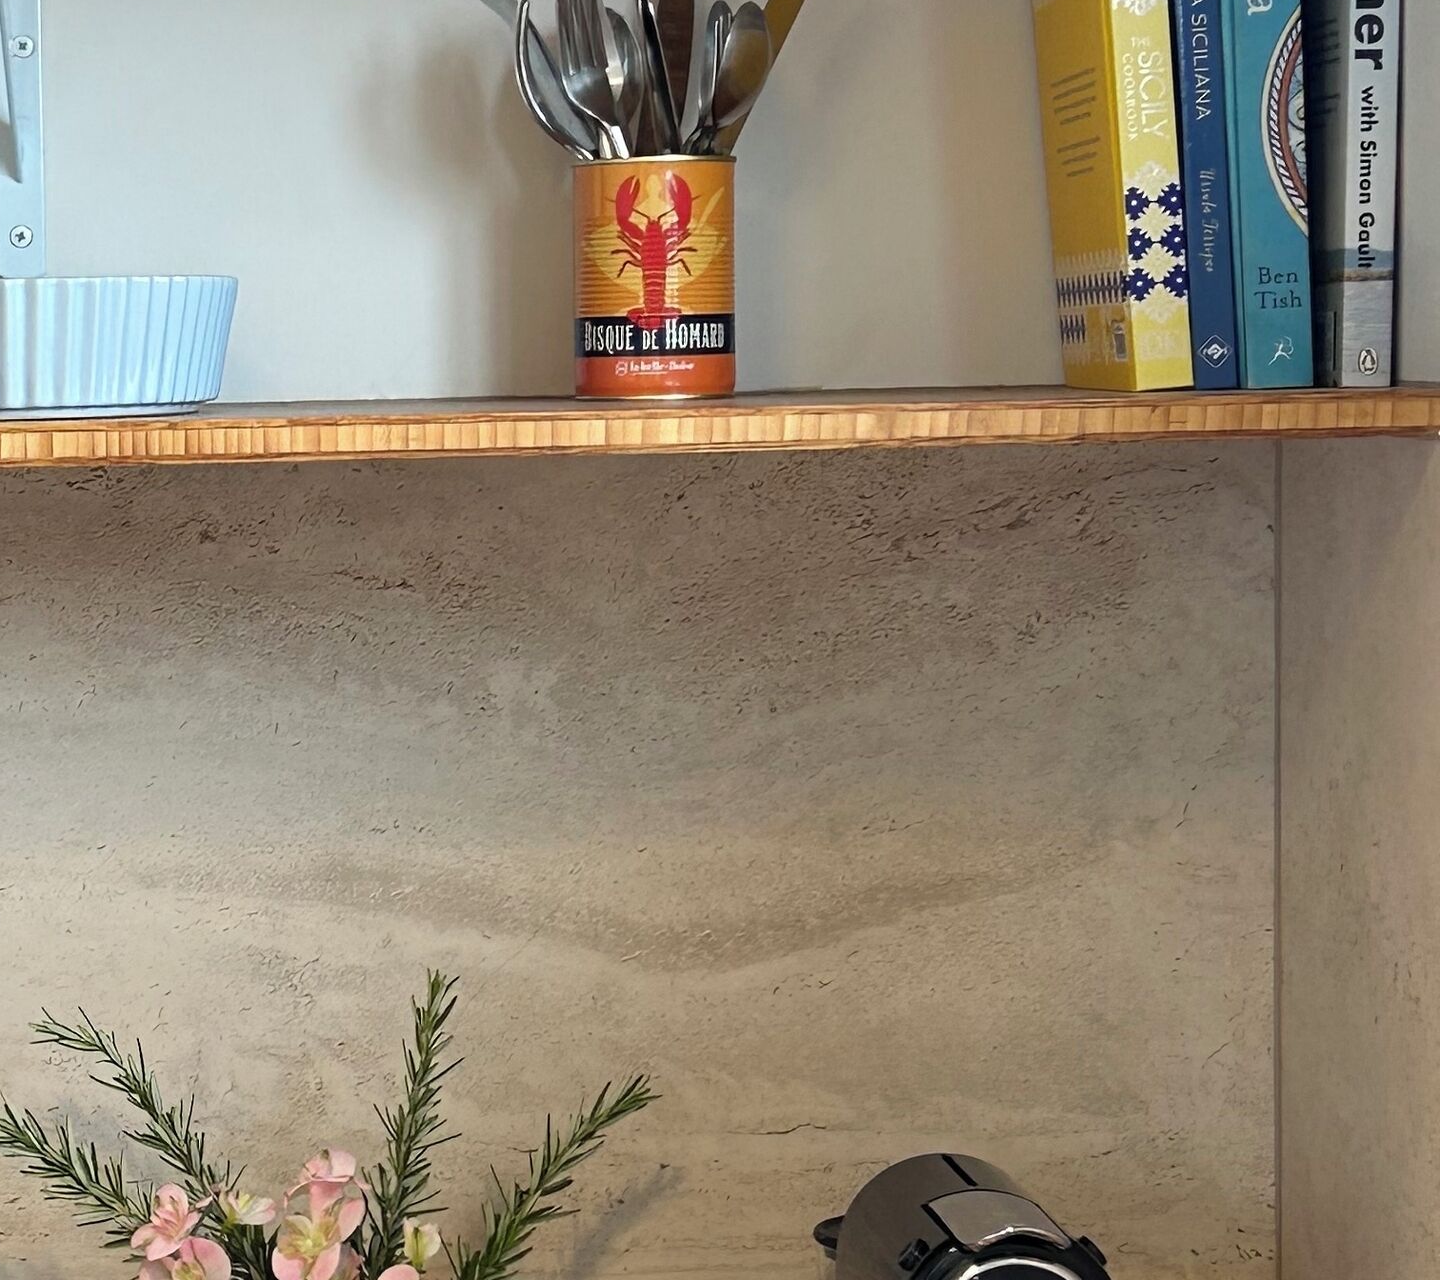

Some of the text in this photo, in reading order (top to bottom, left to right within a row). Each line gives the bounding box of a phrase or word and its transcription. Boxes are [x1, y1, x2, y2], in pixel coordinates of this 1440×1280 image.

[1191, 13, 1212, 121] SICILIANA
[1137, 51, 1169, 139] SICILY
[1360, 85, 1380, 132] with
[1359, 140, 1378, 204] Simon
[1358, 212, 1376, 269] Gault
[1253, 289, 1303, 309] Tish
[1258, 266, 1299, 285] Ben
[584, 316, 725, 355] BISQUE DE HOMARD
